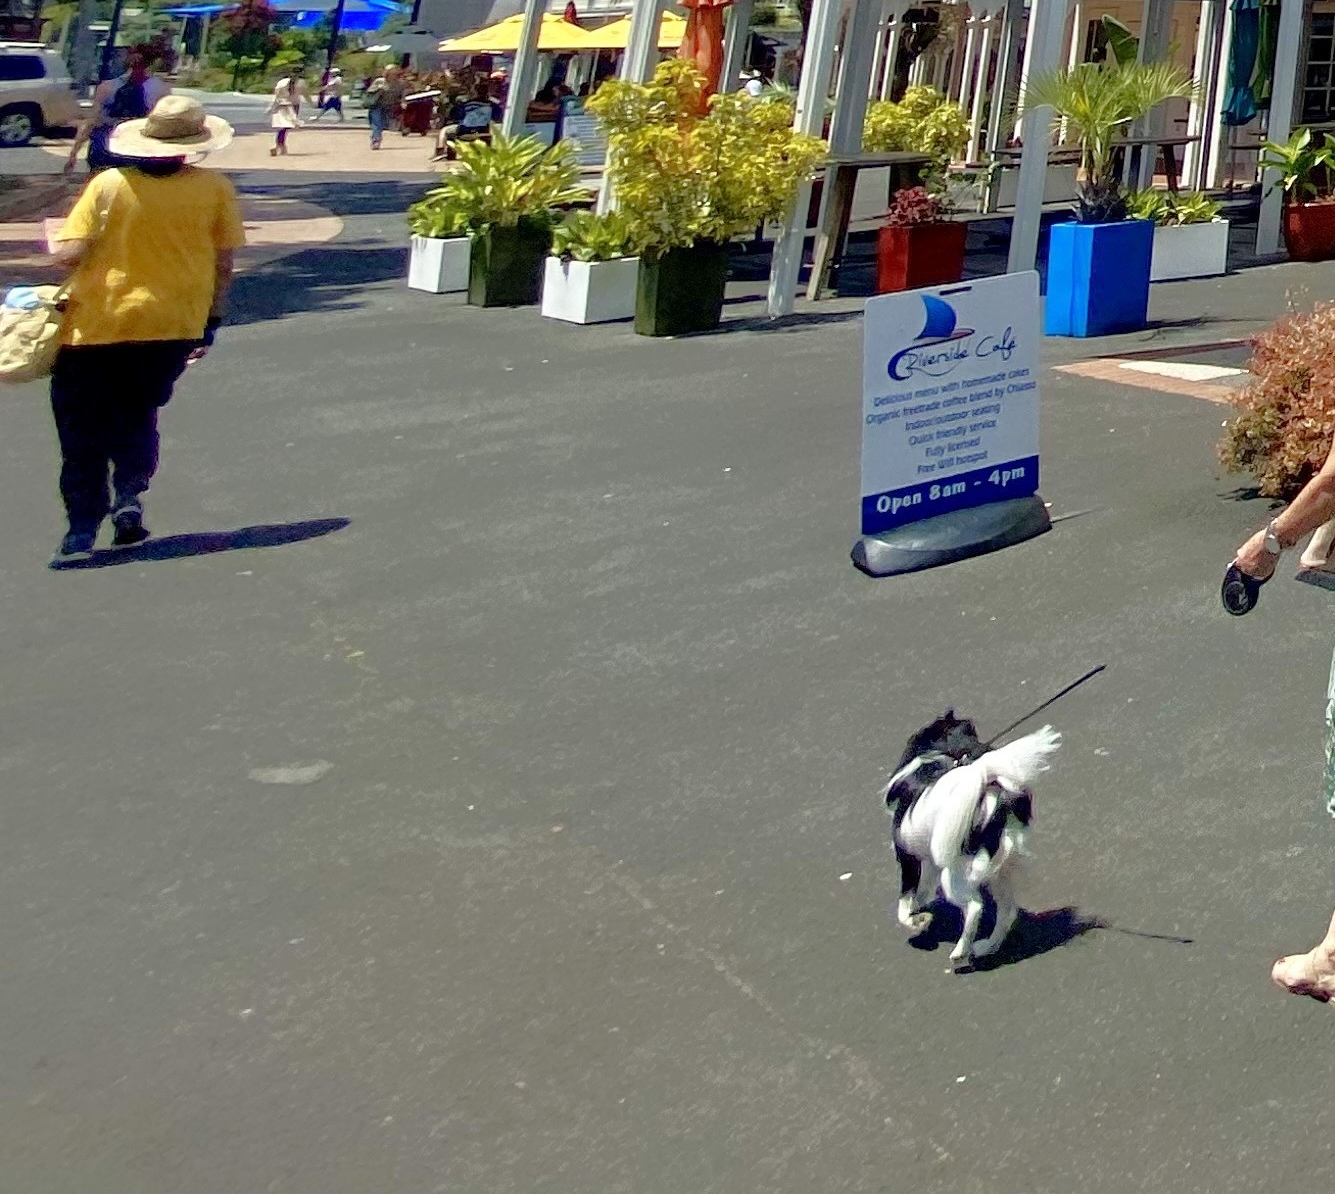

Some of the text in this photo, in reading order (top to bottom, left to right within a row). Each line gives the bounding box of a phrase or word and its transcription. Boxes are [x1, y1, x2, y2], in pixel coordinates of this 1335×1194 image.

[904, 340, 969, 370] Riverside
[873, 368, 1029, 407] Delicious menu with homemade cakes
[866, 410, 900, 425] Organic
[942, 396, 967, 408] coffee
[969, 390, 992, 403] blend
[994, 387, 1004, 399] by
[971, 404, 1000, 418] seating
[908, 420, 996, 447] Quick friendly service
[917, 464, 934, 475] Free
[956, 451, 988, 466] hotspot
[925, 445, 945, 458] Fully
[876, 492, 922, 515] Open
[929, 480, 966, 501] 8am
[988, 466, 1025, 488] 4pm
